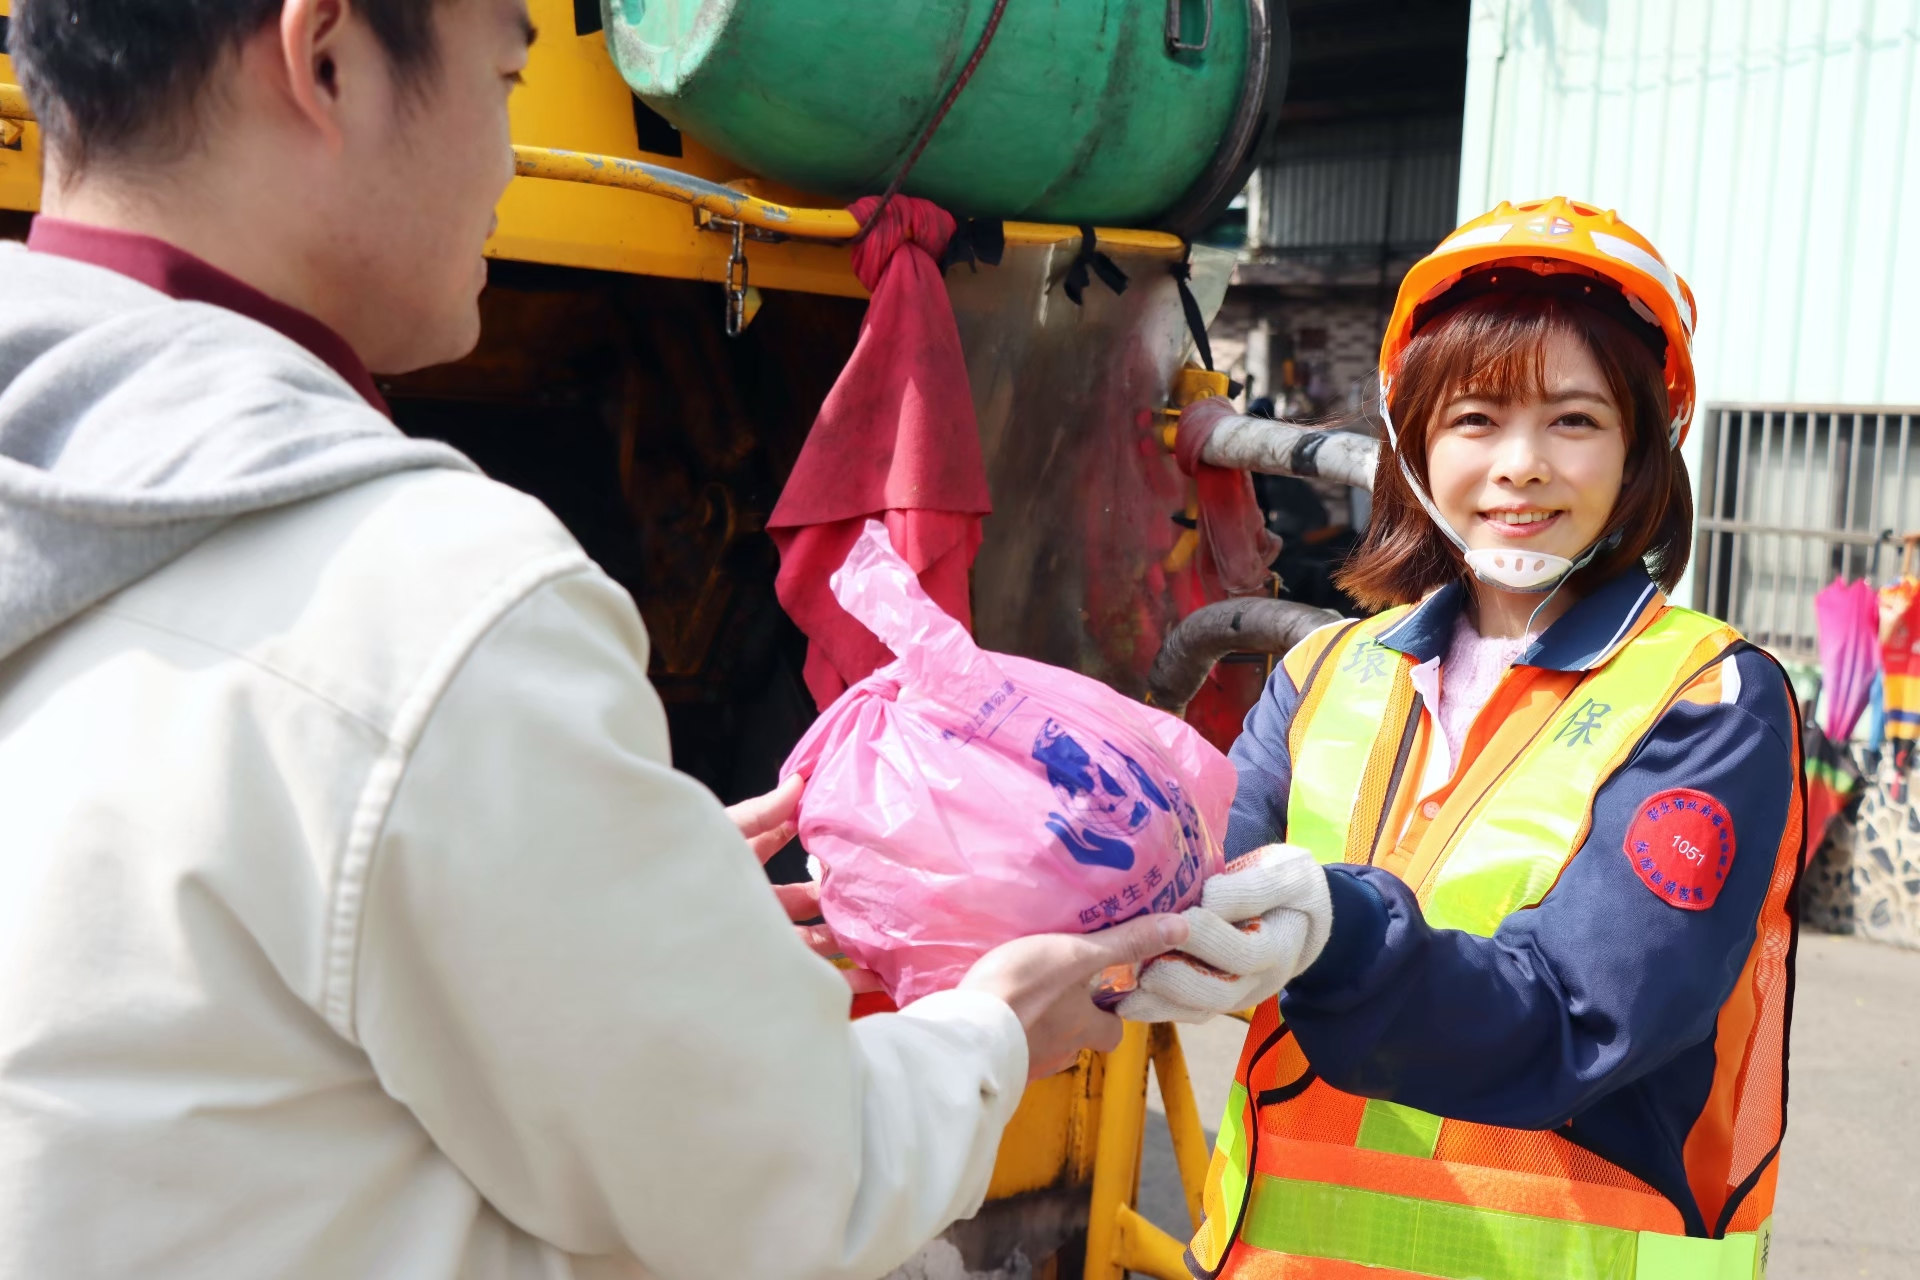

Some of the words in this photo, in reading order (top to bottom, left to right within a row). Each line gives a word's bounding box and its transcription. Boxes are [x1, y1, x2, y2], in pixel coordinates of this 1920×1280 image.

[1342, 640, 1387, 684] 環
[1552, 697, 1612, 748] 保
[1671, 835, 1705, 866] 1051
[1078, 865, 1163, 925] 低碳生活
